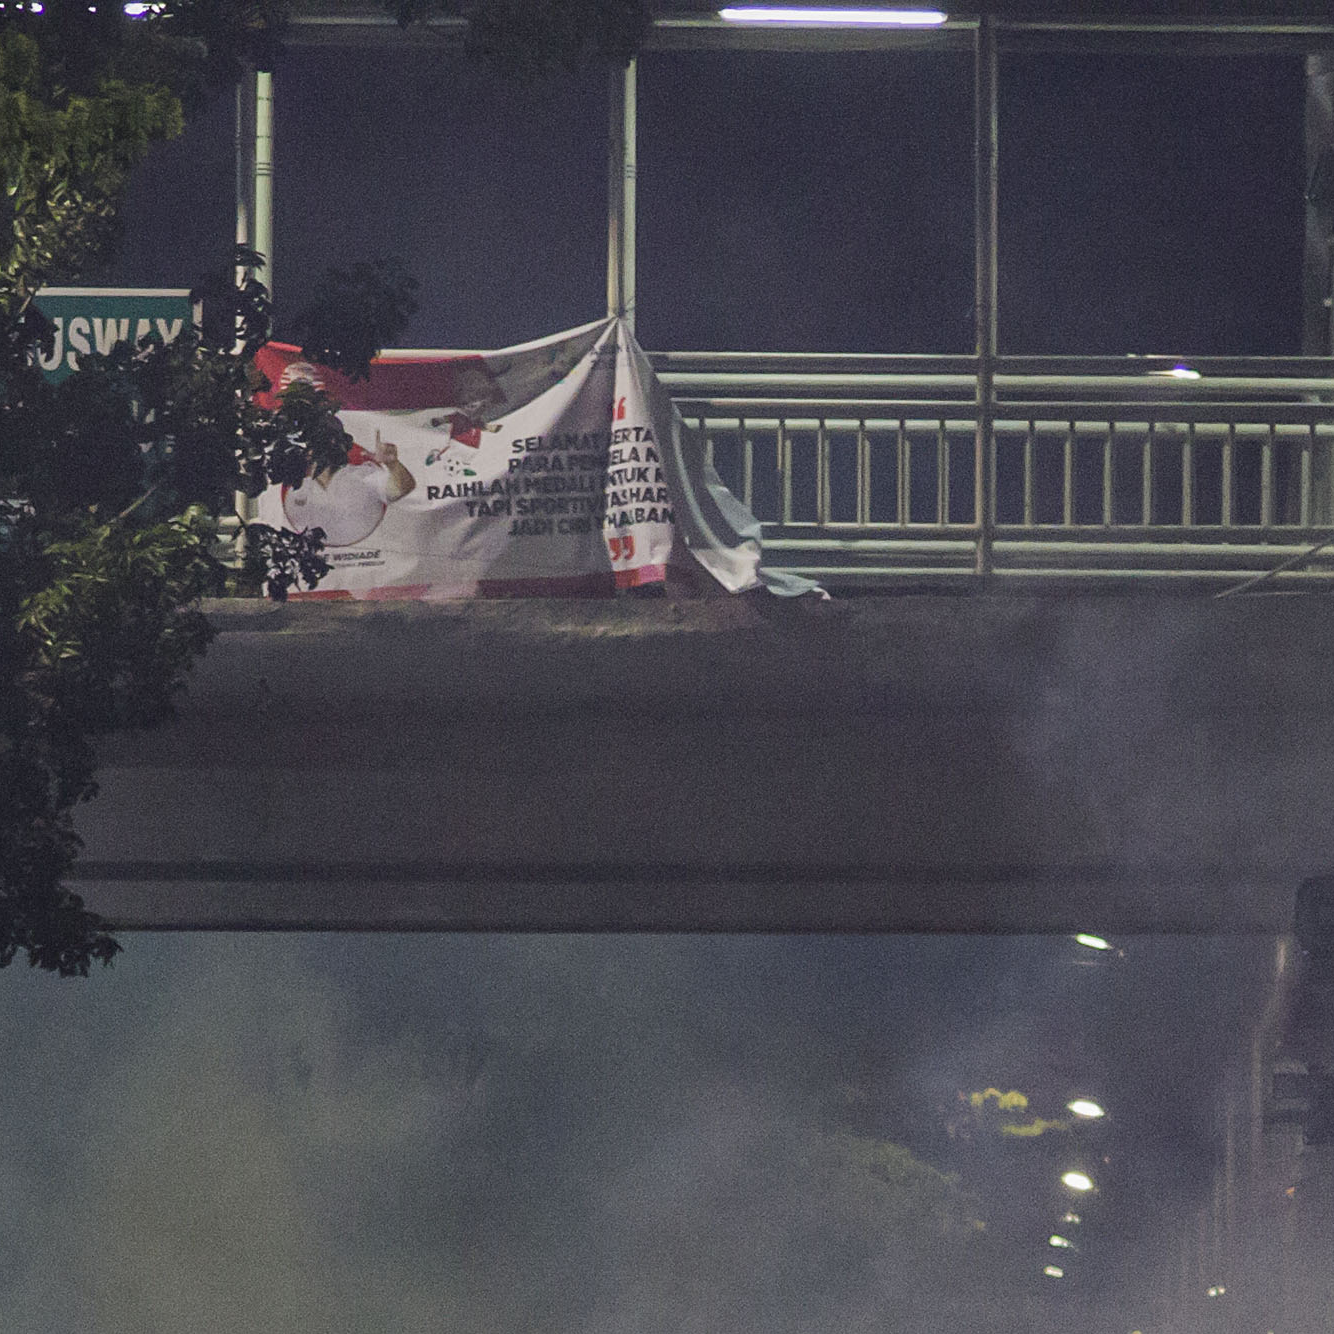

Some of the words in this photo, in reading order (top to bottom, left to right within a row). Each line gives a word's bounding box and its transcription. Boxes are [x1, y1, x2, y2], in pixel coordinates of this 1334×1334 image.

[509, 455, 564, 474] PARA
[427, 477, 520, 500] RAIHLAH
[466, 497, 511, 518] TAPI
